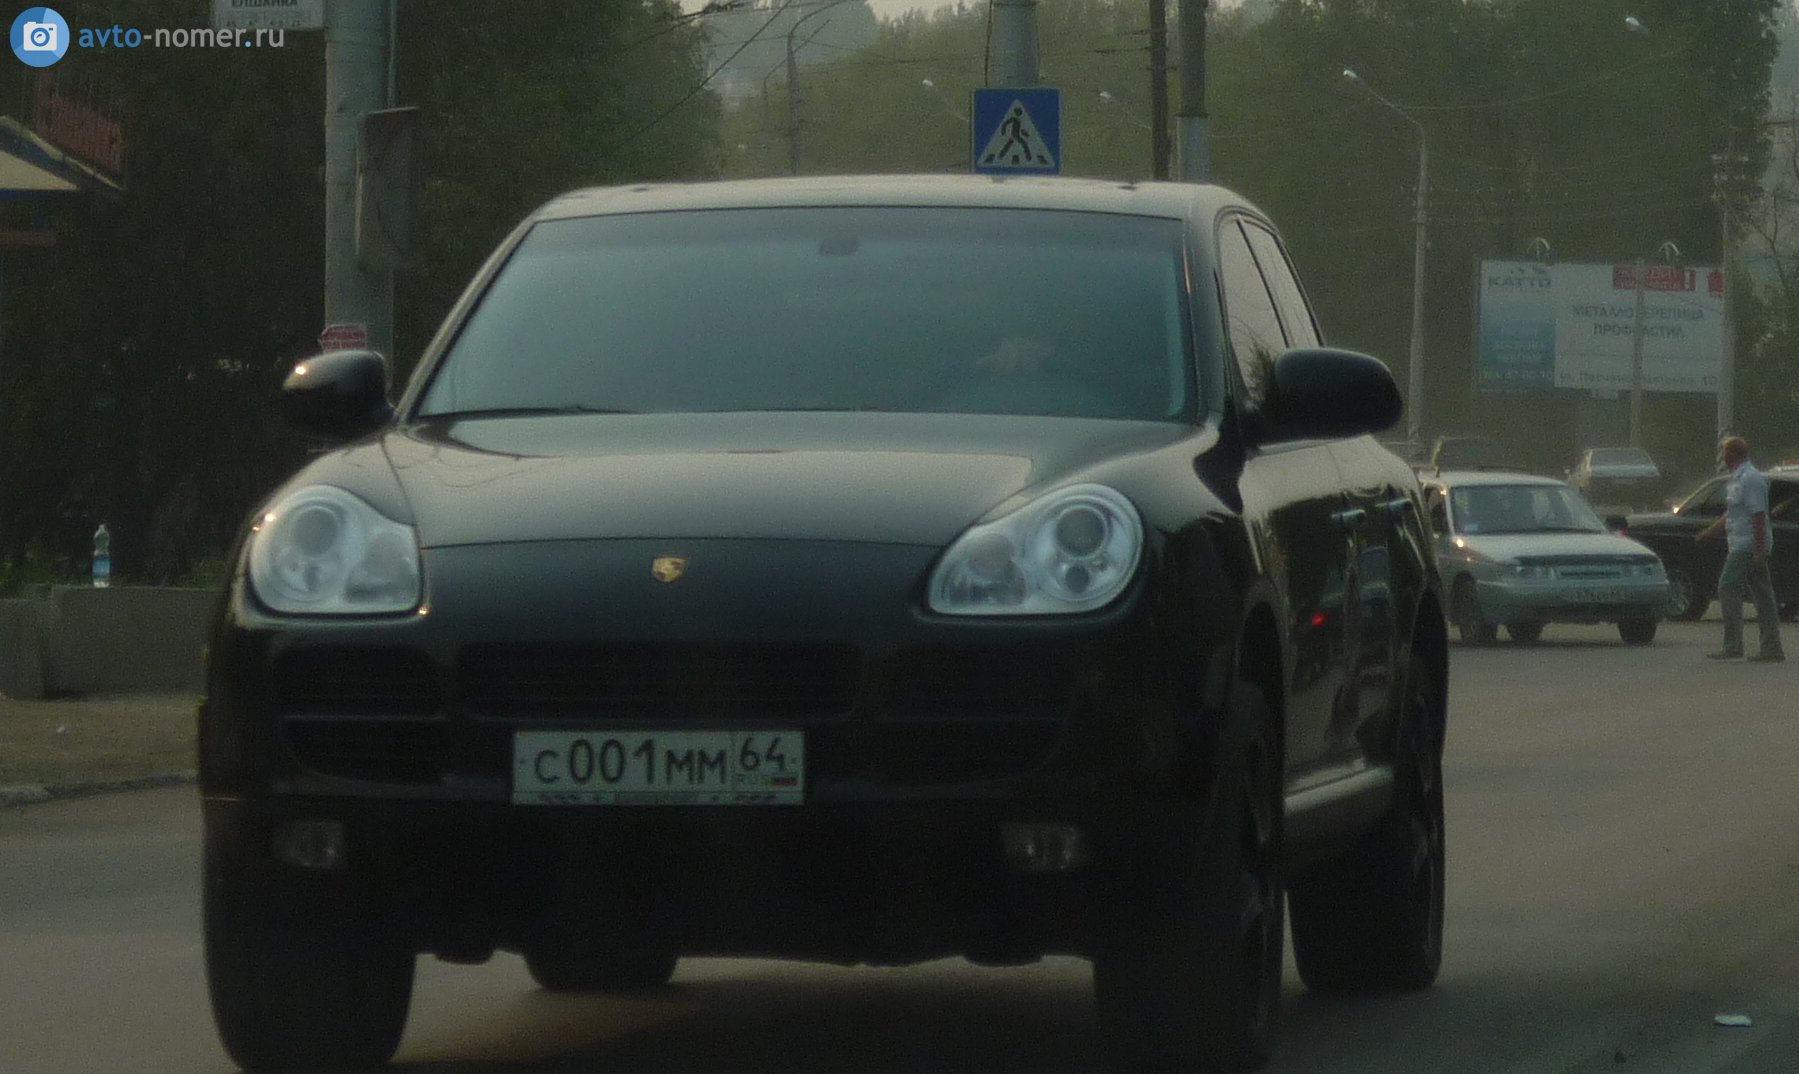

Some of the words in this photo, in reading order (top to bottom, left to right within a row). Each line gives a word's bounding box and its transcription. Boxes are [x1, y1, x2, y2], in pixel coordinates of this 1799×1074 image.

[1572, 305, 1705, 320] МЕТАЛЛОЕРЕПИЦА
[1593, 323, 1684, 338] ПРОФАСТИЛ
[739, 737, 786, 771] 64
